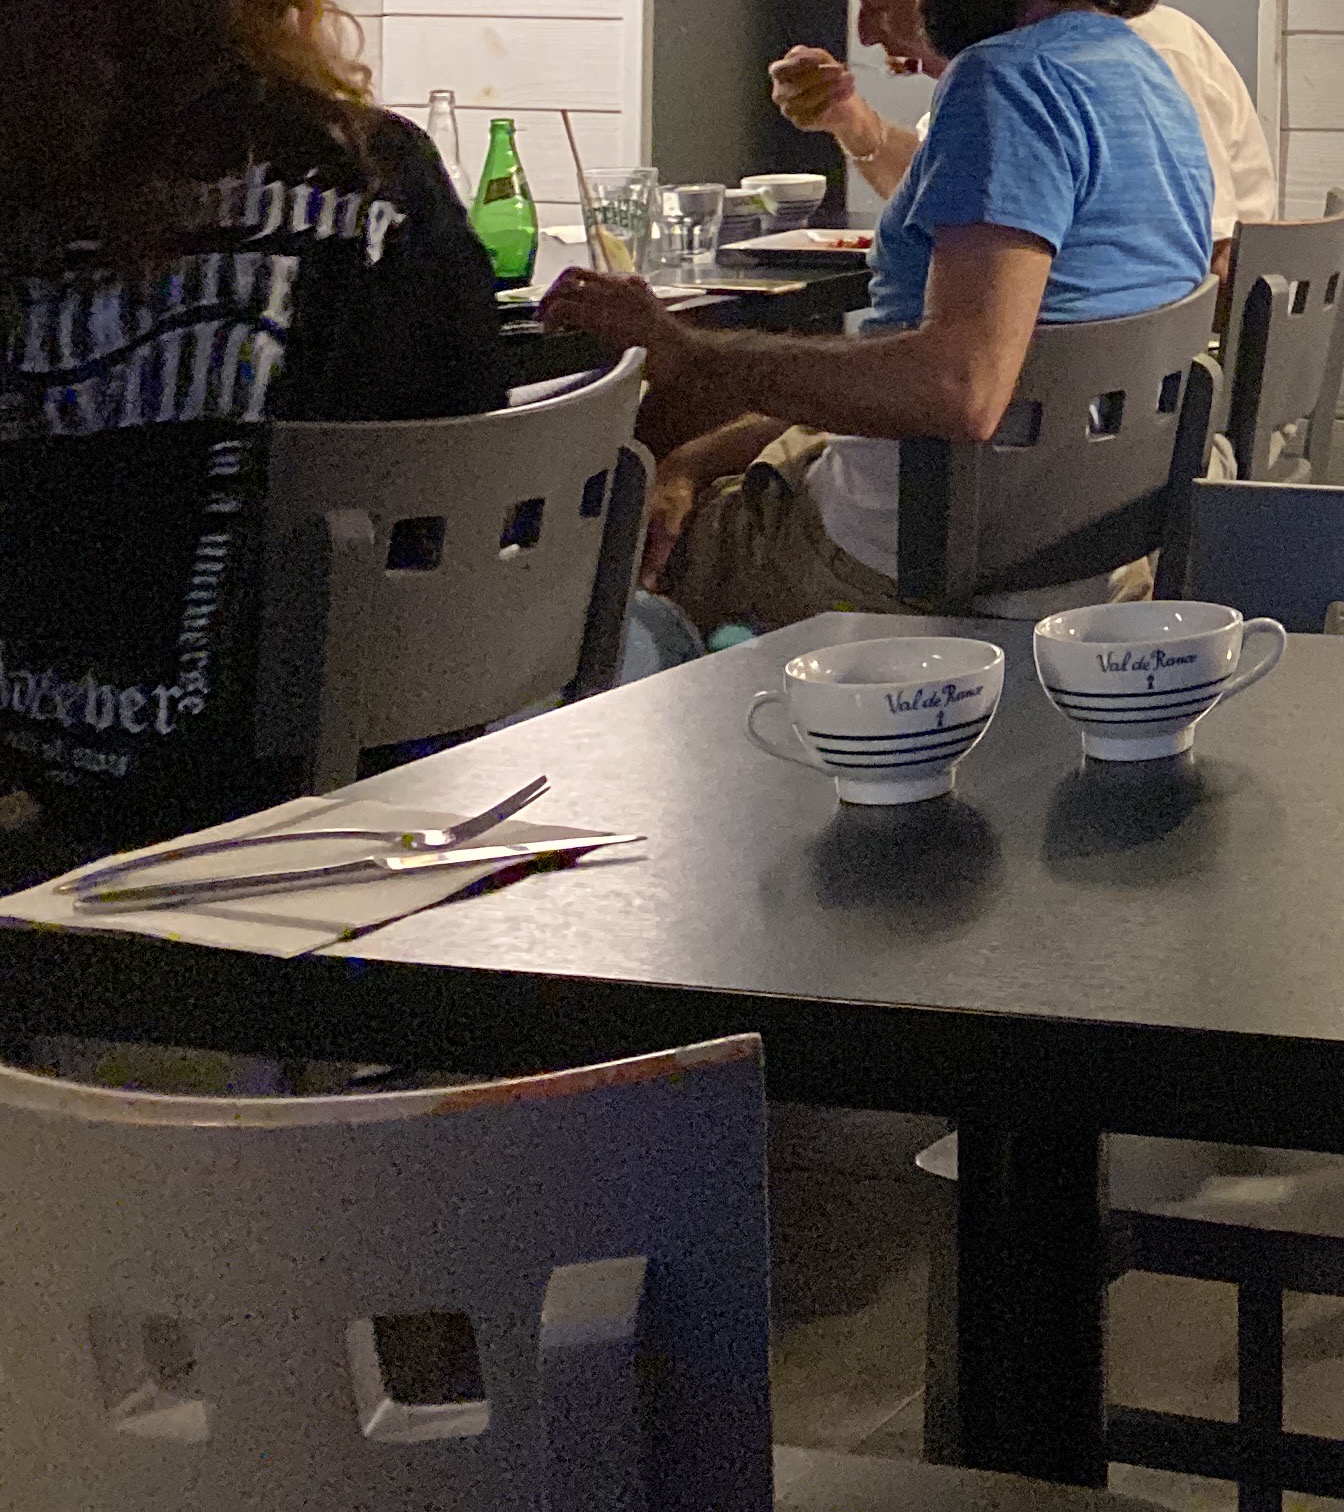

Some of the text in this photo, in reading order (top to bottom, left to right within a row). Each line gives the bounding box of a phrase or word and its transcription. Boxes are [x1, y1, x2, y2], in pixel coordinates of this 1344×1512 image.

[1096, 651, 1132, 673] Val
[1132, 655, 1150, 671] de
[885, 688, 923, 714] Val
[923, 691, 941, 708] de
